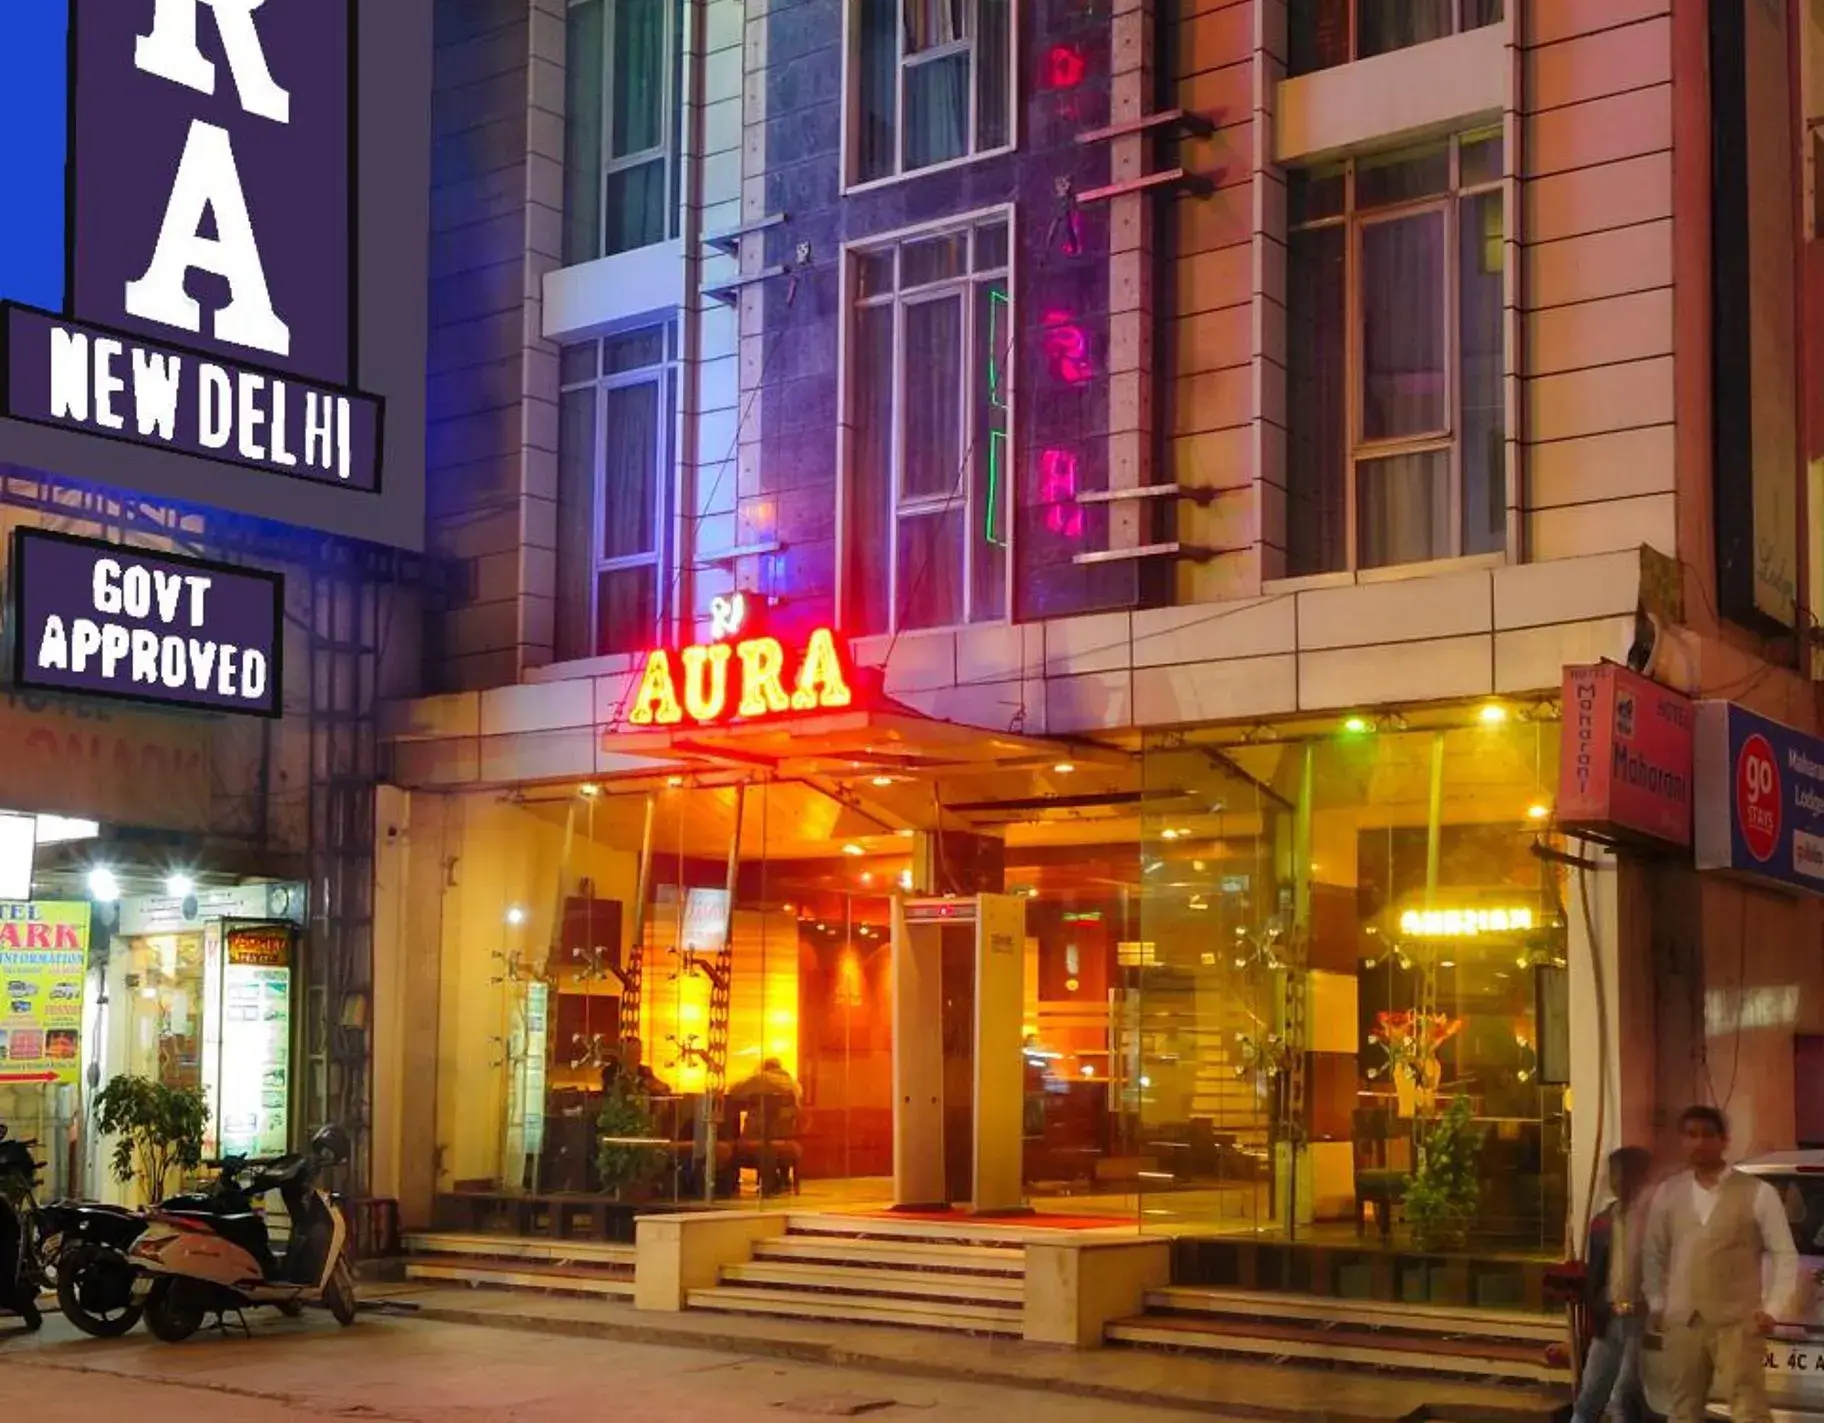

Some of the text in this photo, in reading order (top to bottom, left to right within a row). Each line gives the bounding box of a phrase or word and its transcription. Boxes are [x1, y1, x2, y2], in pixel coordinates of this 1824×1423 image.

[51, 327, 350, 479] NEW DELHI
[92, 558, 212, 627] GOVT
[38, 624, 267, 699] APPROVED
[629, 627, 851, 724] AURA
[1746, 755, 1773, 803] go
[1787, 1354, 1807, 1371] 4C
